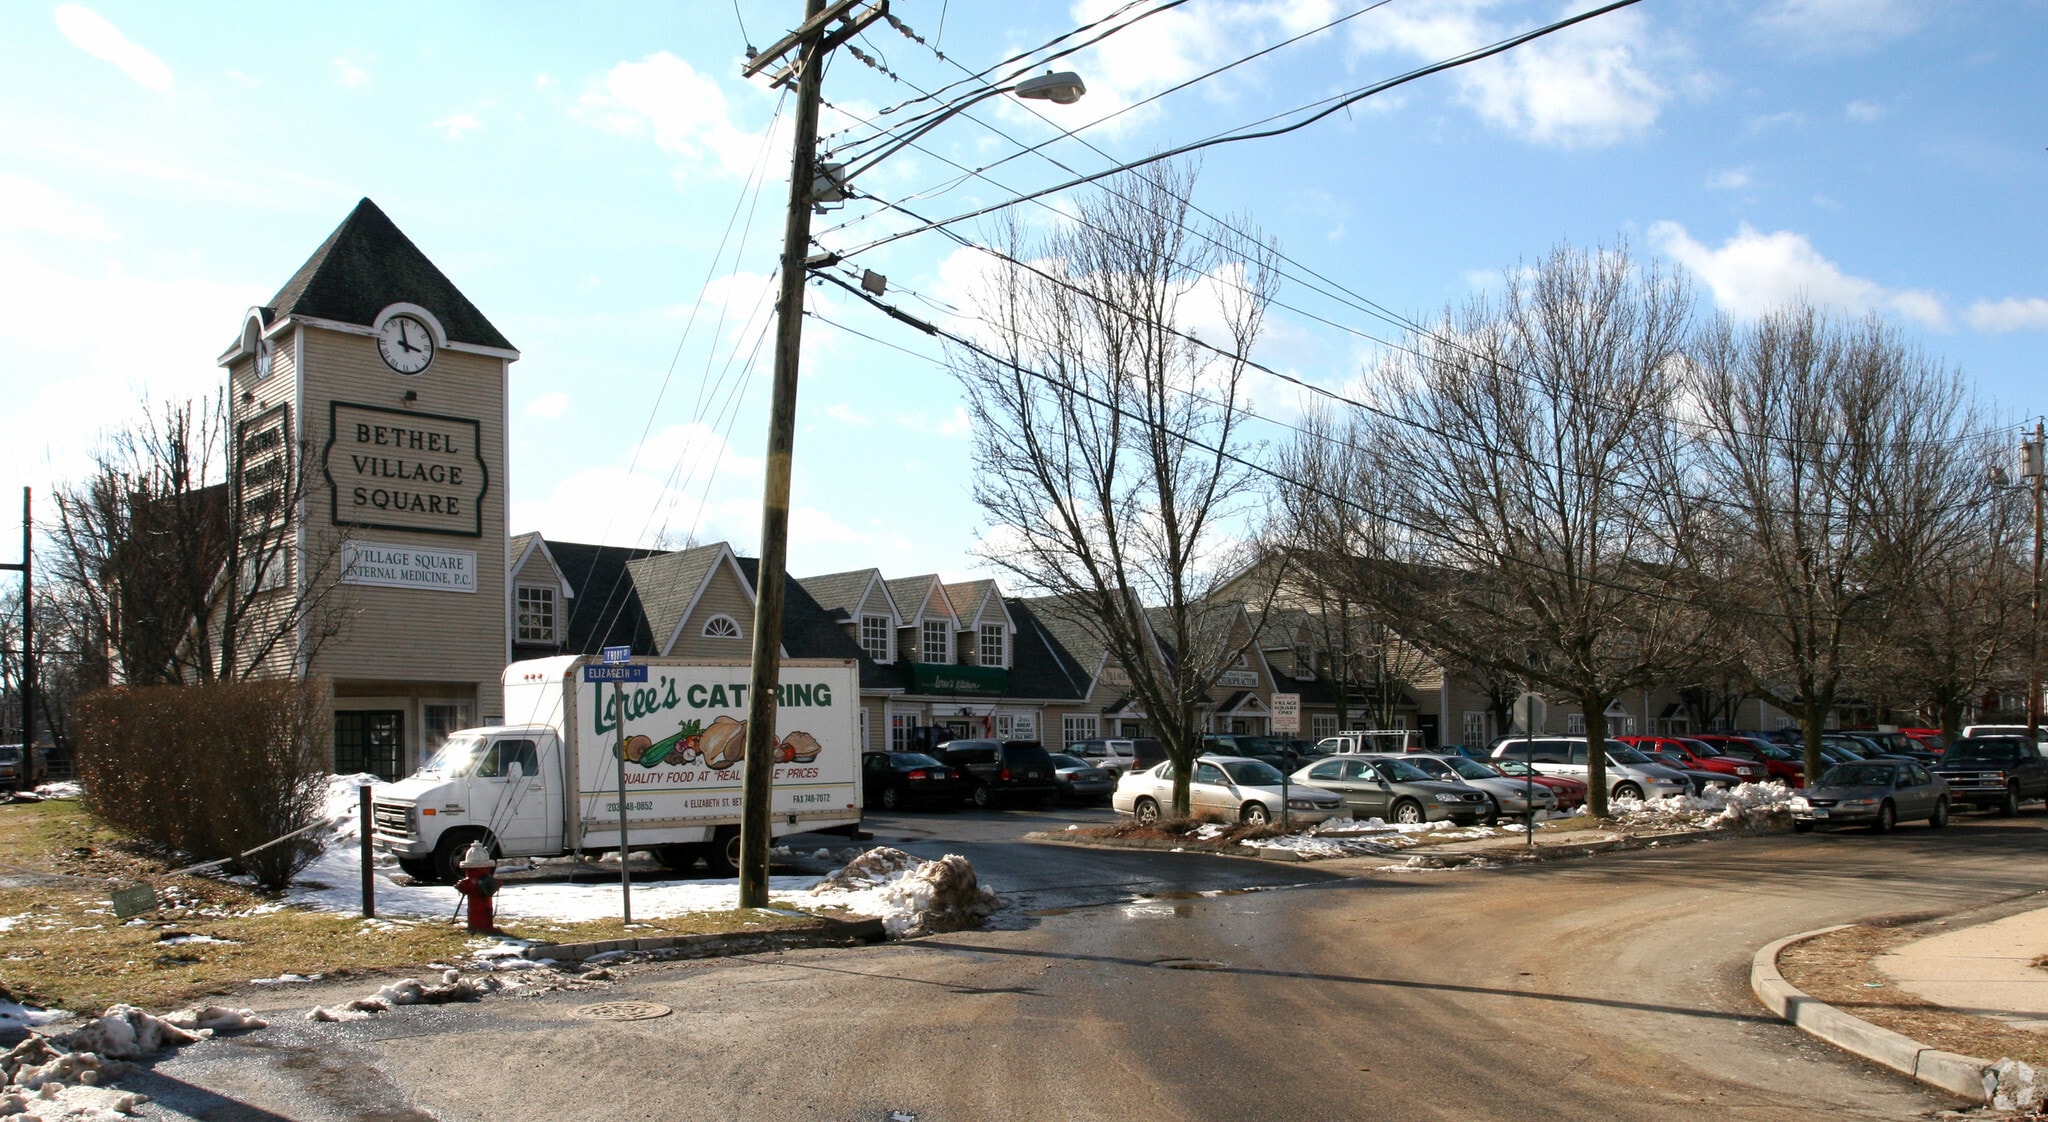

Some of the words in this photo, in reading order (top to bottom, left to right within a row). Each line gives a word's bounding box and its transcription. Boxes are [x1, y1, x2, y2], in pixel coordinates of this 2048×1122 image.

[356, 423, 458, 453] BETHEL
[351, 455, 462, 485] VILLAGE
[354, 487, 460, 515] SQUARE
[355, 550, 409, 566] VILLAGE
[415, 554, 464, 570] SQUARE
[346, 565, 397, 579] INTERNAL
[401, 570, 450, 585] MEDICINE,
[454, 574, 471, 585] P.C.
[589, 668, 630, 679] ELIZABETH
[633, 669, 641, 677] ST
[687, 683, 832, 709] CATING
[666, 771, 694, 783] FOOD
[698, 770, 711, 781] AT
[787, 768, 818, 778] PRICES
[690, 799, 720, 808] ELIZABETH
[793, 795, 804, 803] FAX
[805, 793, 831, 803] 748-7072
